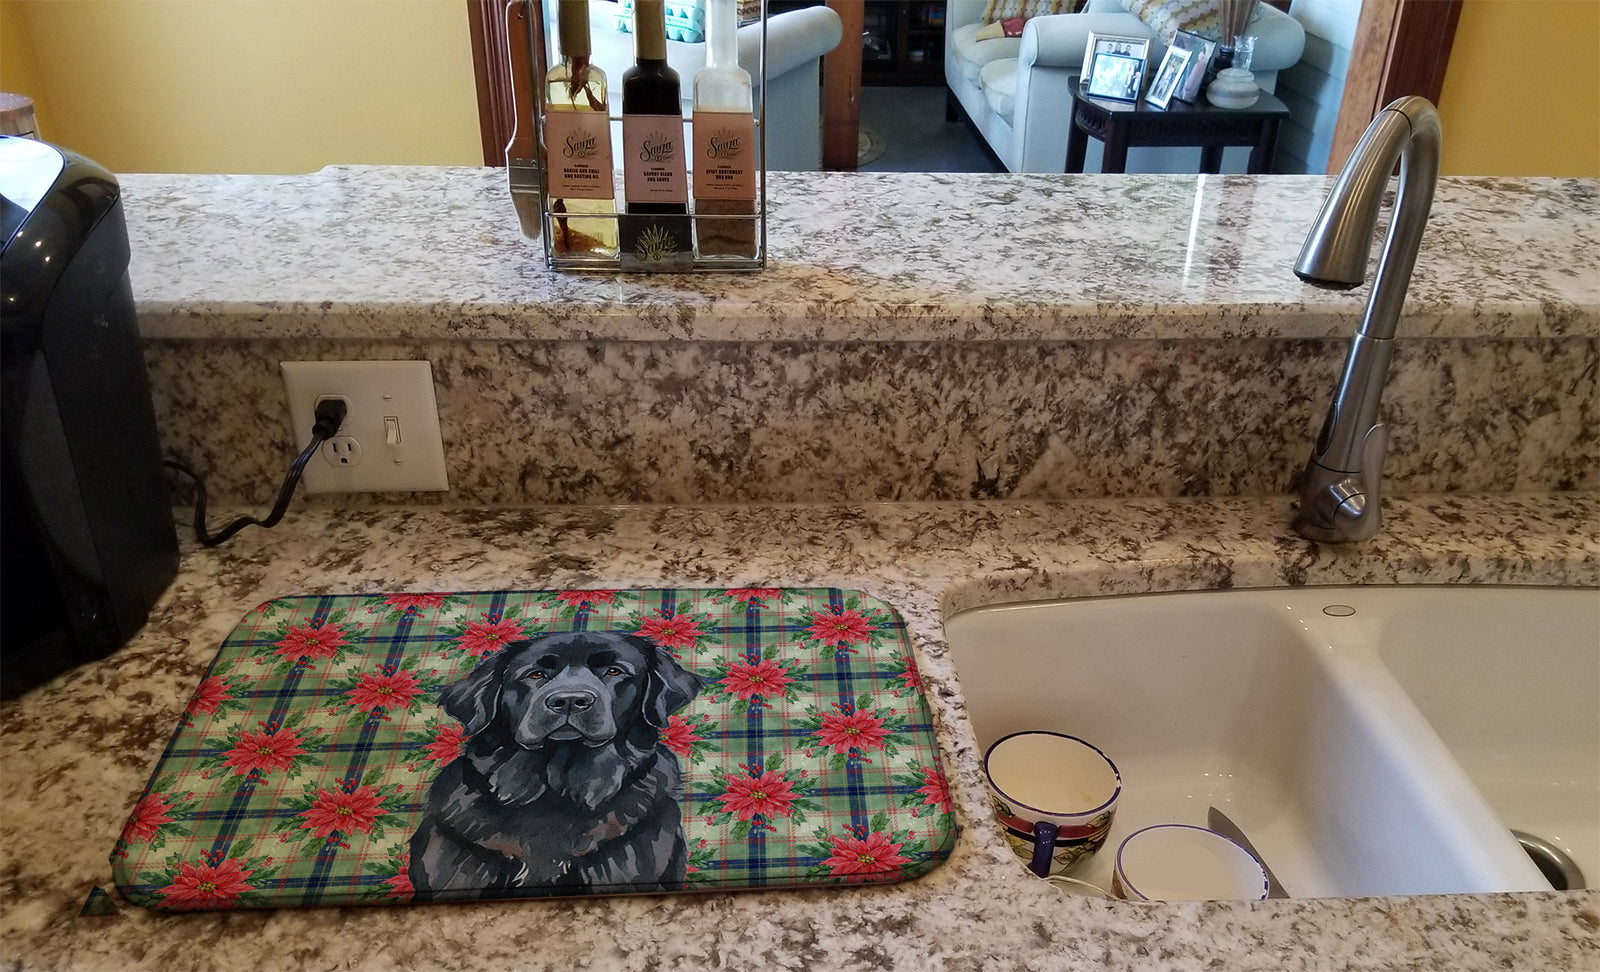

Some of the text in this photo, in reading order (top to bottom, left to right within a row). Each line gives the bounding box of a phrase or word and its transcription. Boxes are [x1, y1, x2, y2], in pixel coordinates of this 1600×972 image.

[563, 136, 597, 158] Sauza
[640, 140, 673, 161] Sauza
[707, 137, 740, 159] Sauza
